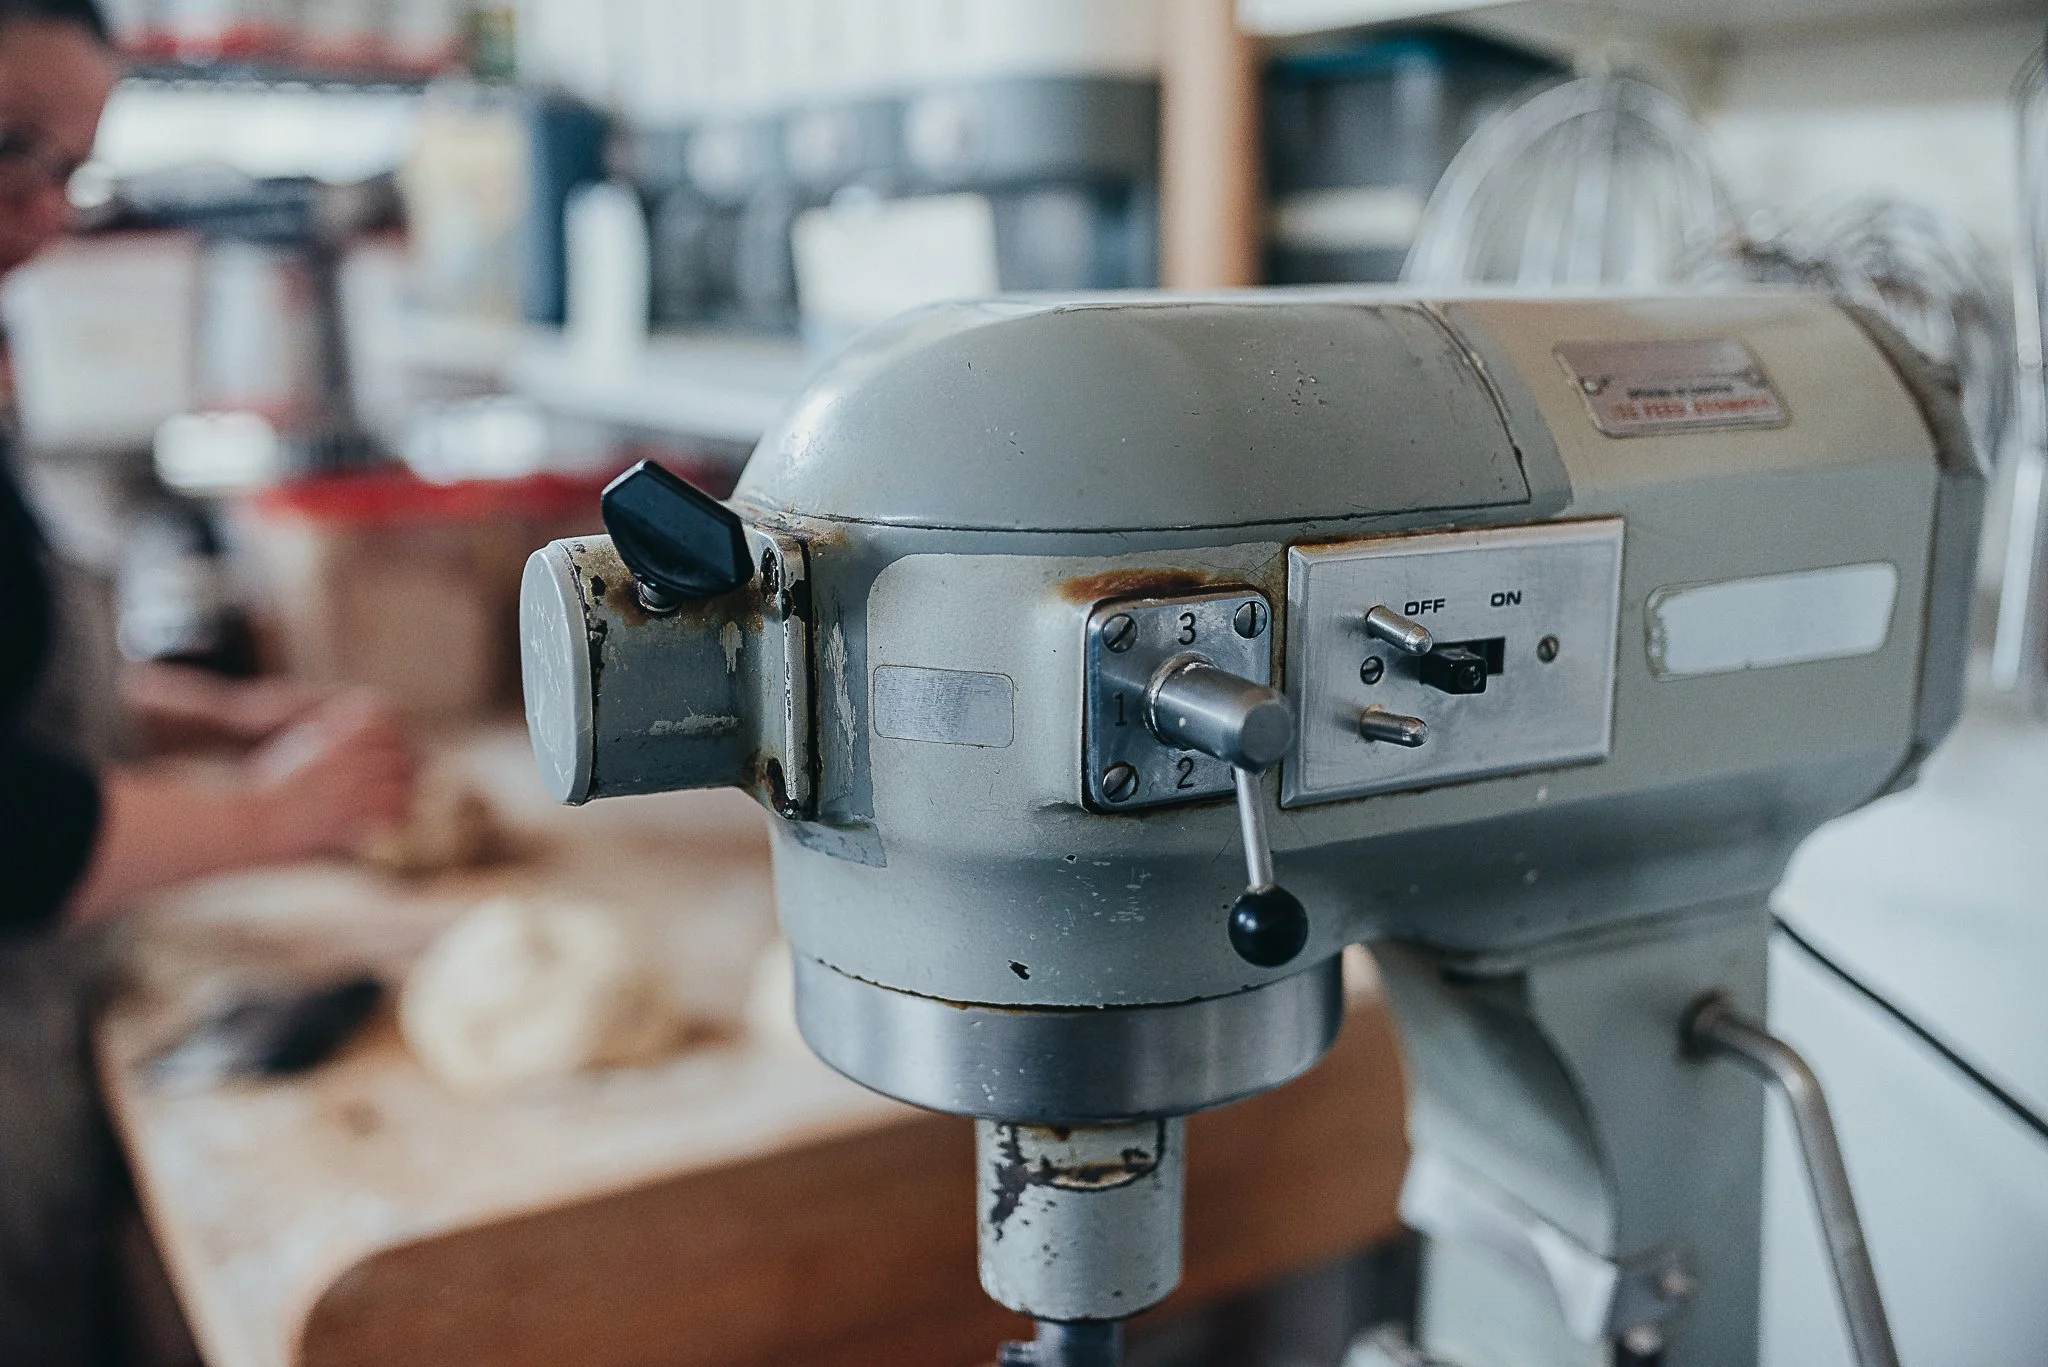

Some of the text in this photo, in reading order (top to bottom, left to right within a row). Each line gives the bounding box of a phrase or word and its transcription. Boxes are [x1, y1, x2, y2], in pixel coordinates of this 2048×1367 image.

[1404, 591, 1522, 616] OFF ON
[1177, 612, 1197, 645] 3
[1112, 692, 1128, 727] 1
[1176, 756, 1195, 790] 2
